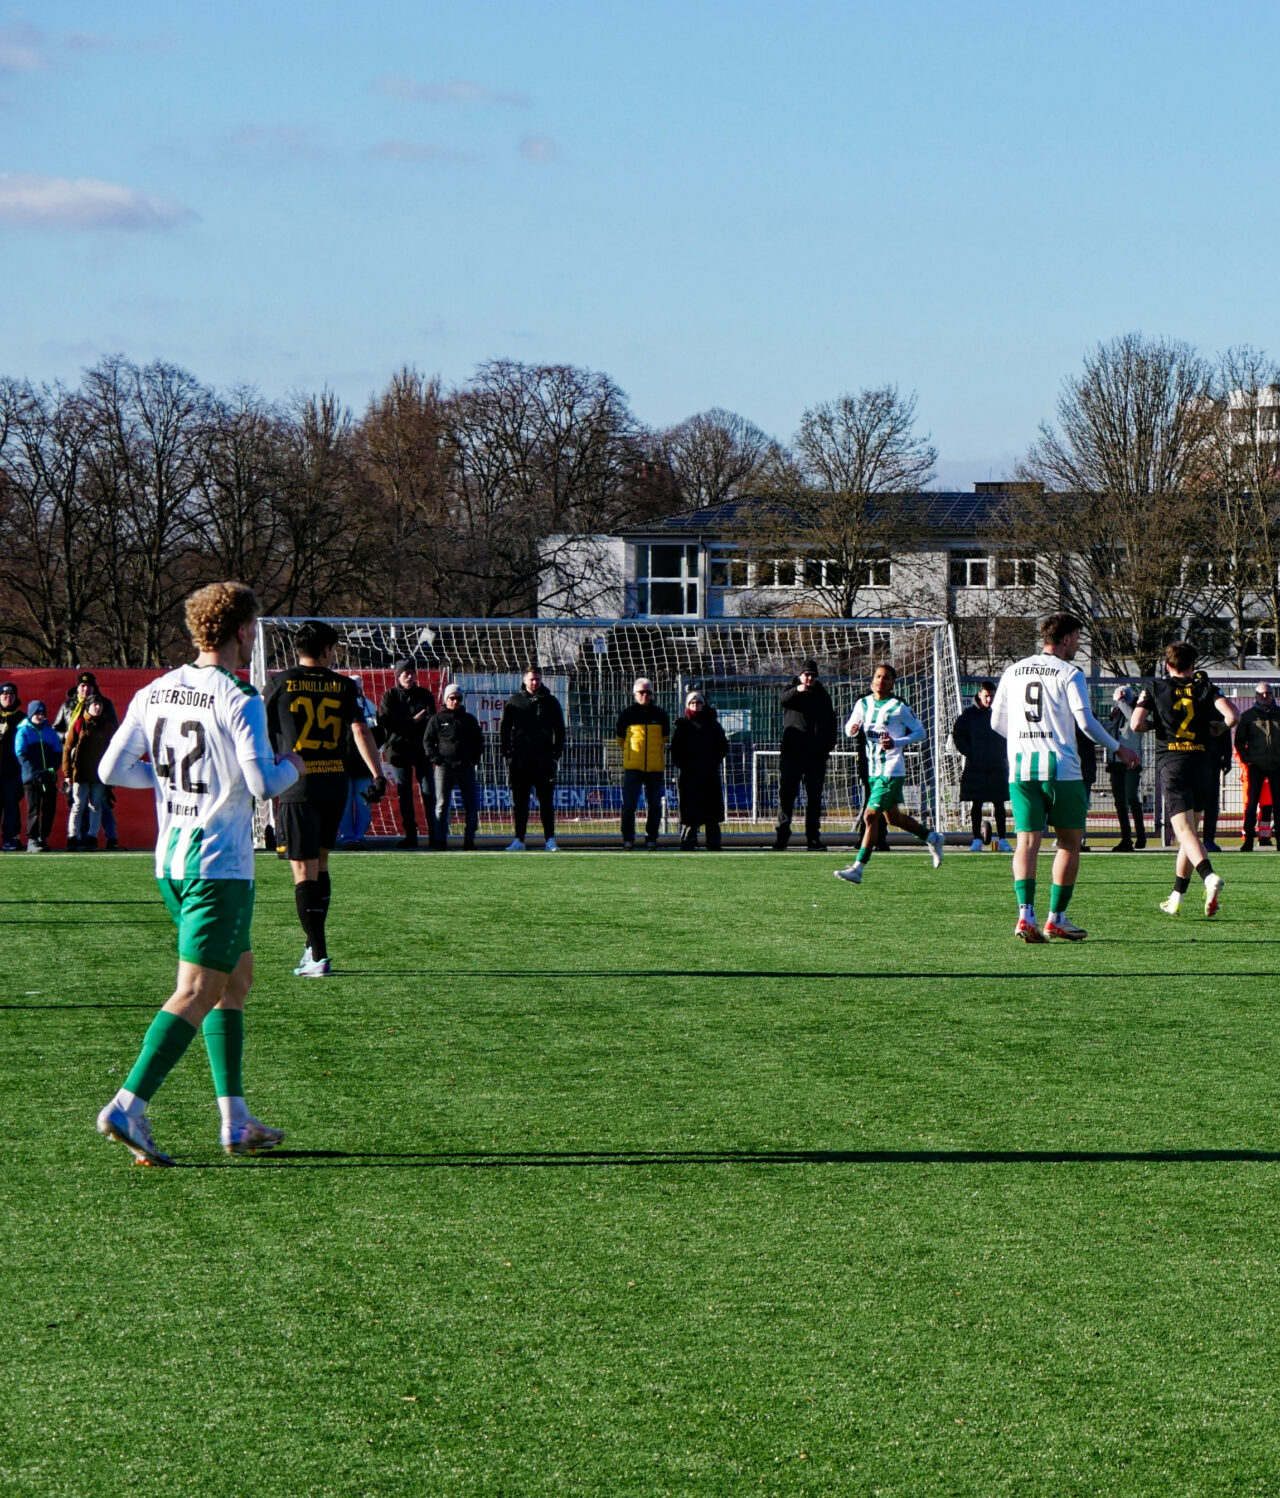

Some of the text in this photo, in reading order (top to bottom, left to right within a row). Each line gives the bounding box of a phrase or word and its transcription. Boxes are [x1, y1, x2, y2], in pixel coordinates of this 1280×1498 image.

[290, 696, 342, 752] 25
[1025, 682, 1043, 722] 9
[1173, 697, 1196, 740] 2
[152, 717, 208, 794] 42
